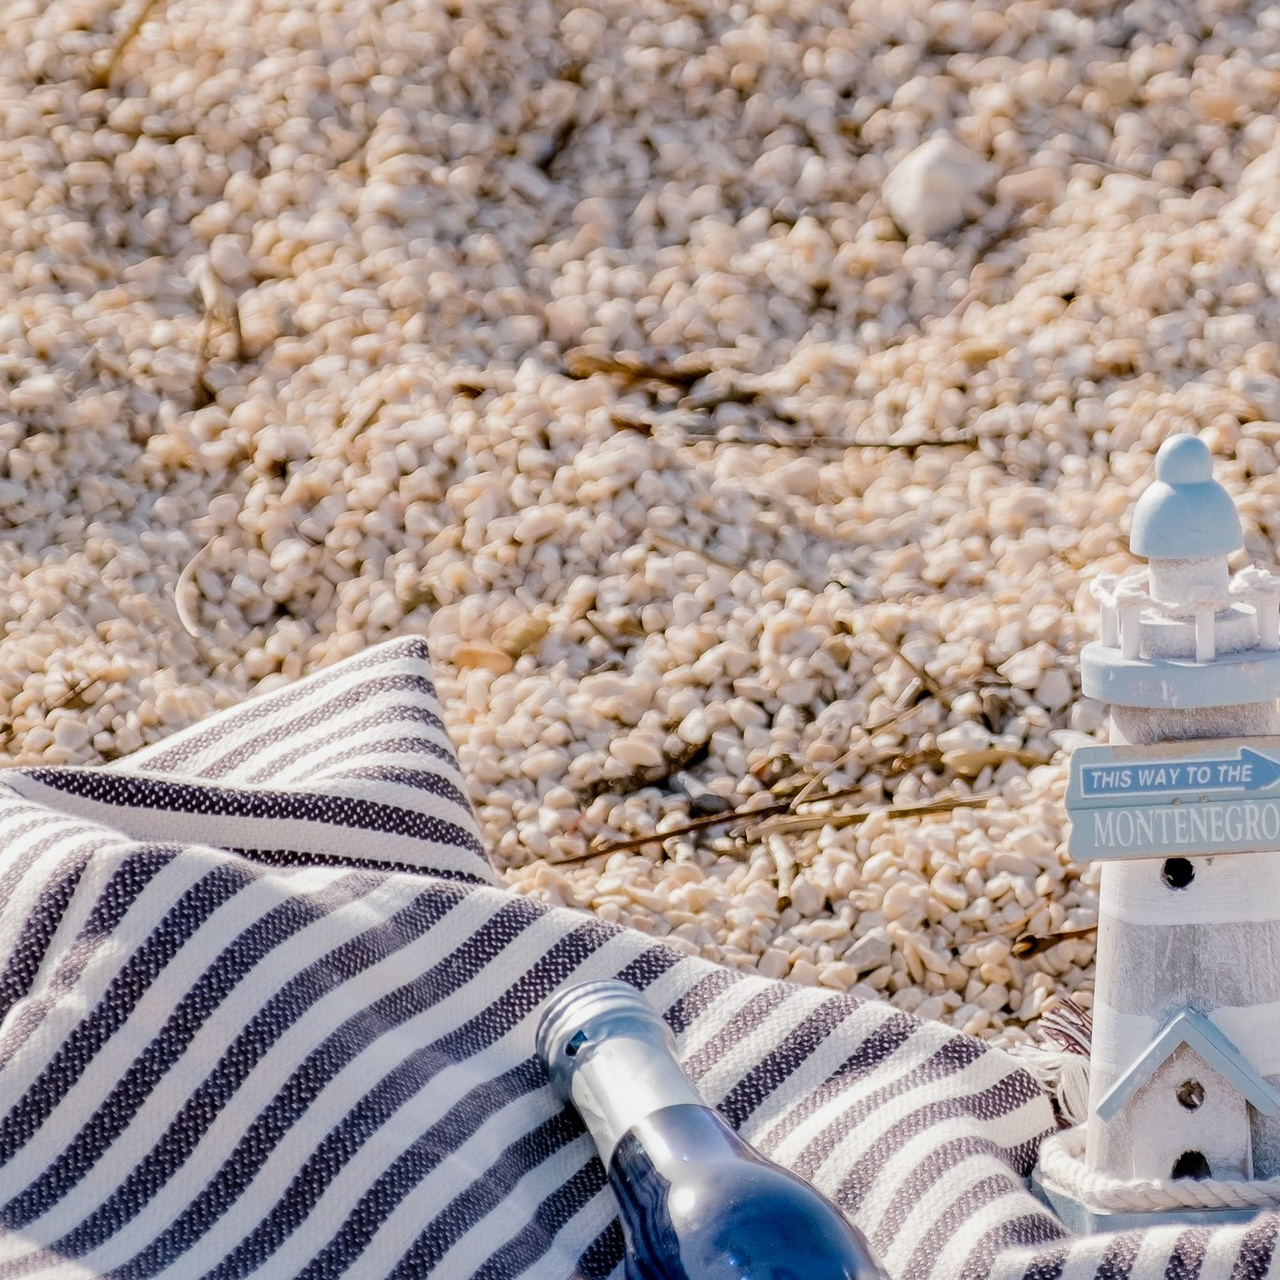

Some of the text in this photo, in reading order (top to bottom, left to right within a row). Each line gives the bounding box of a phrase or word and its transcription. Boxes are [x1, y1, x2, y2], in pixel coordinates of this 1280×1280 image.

[1091, 764, 1253, 789] THIS WAY TO THE
[1093, 803, 1280, 848] MONTENEGRO
